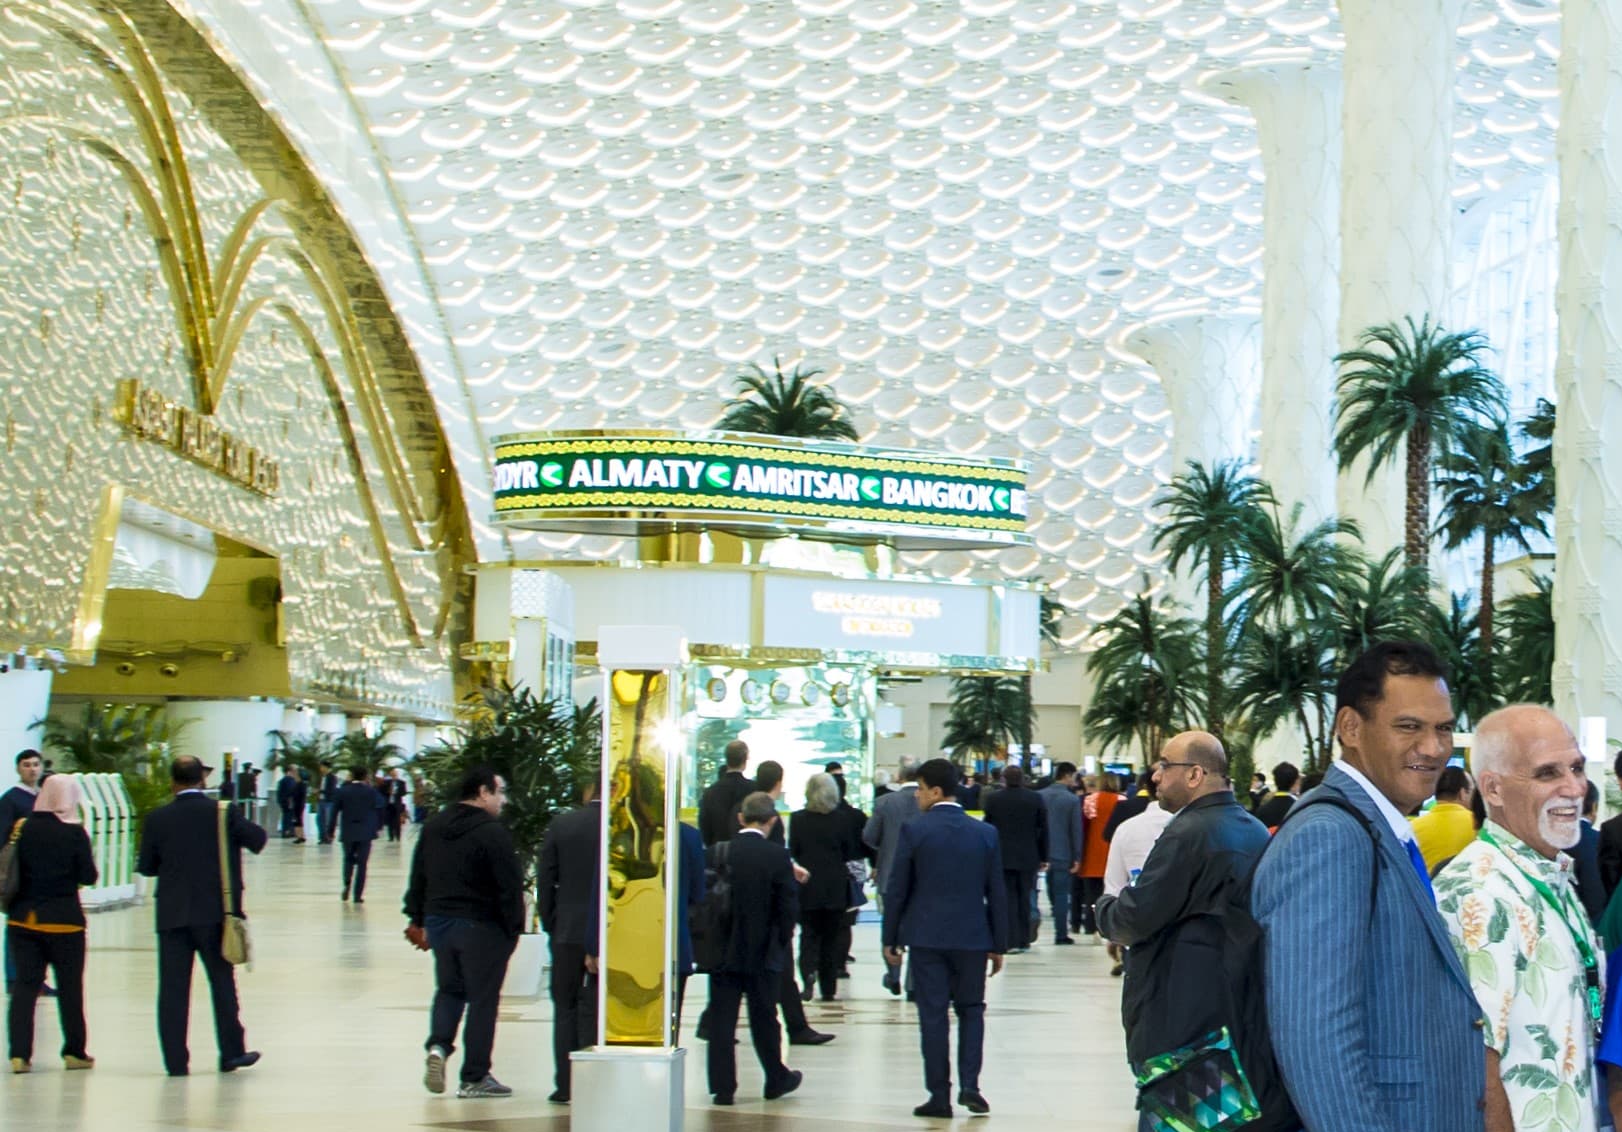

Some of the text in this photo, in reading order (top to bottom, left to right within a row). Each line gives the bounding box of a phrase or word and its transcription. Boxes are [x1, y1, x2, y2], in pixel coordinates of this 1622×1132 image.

[569, 459, 706, 489] ALMATY
[732, 464, 860, 501] AMRITSAR
[882, 476, 994, 512] BANGKOK
